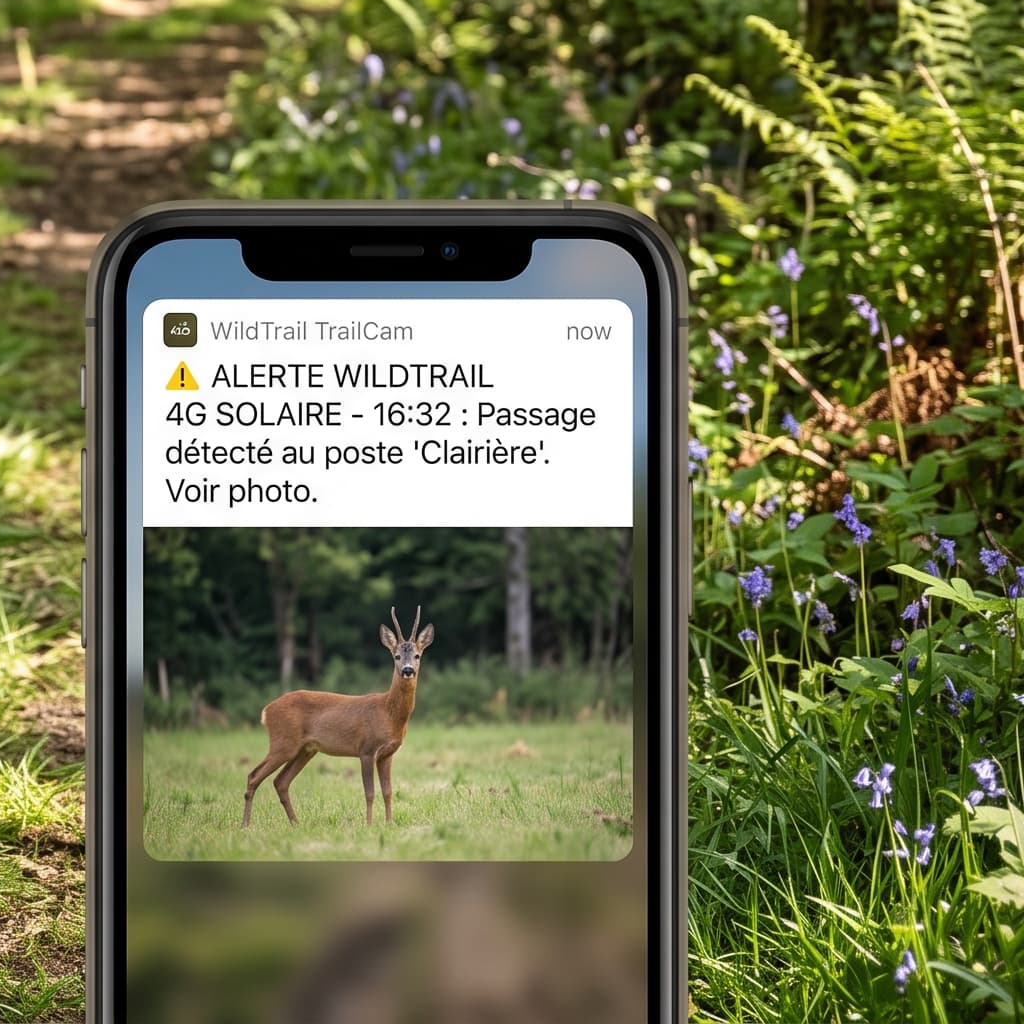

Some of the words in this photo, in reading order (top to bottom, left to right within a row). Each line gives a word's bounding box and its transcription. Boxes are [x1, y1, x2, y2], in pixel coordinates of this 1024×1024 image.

[210, 320, 307, 341] WildTrail
[314, 320, 413, 341] TrailCam
[566, 325, 612, 341] now
[211, 364, 324, 389] ALERTE
[333, 364, 494, 389] WILDTRAIL
[166, 402, 207, 427] 4G
[215, 402, 342, 427] SOLAIRE
[373, 402, 452, 427] 16:32
[478, 402, 597, 433] Passage
[165, 438, 273, 465] détecté
[281, 445, 315, 465] au
[325, 441, 404, 471] poste
[414, 438, 550, 465] 'Clairière'.
[165, 477, 221, 503] Voir
[229, 477, 318, 509] photo.
